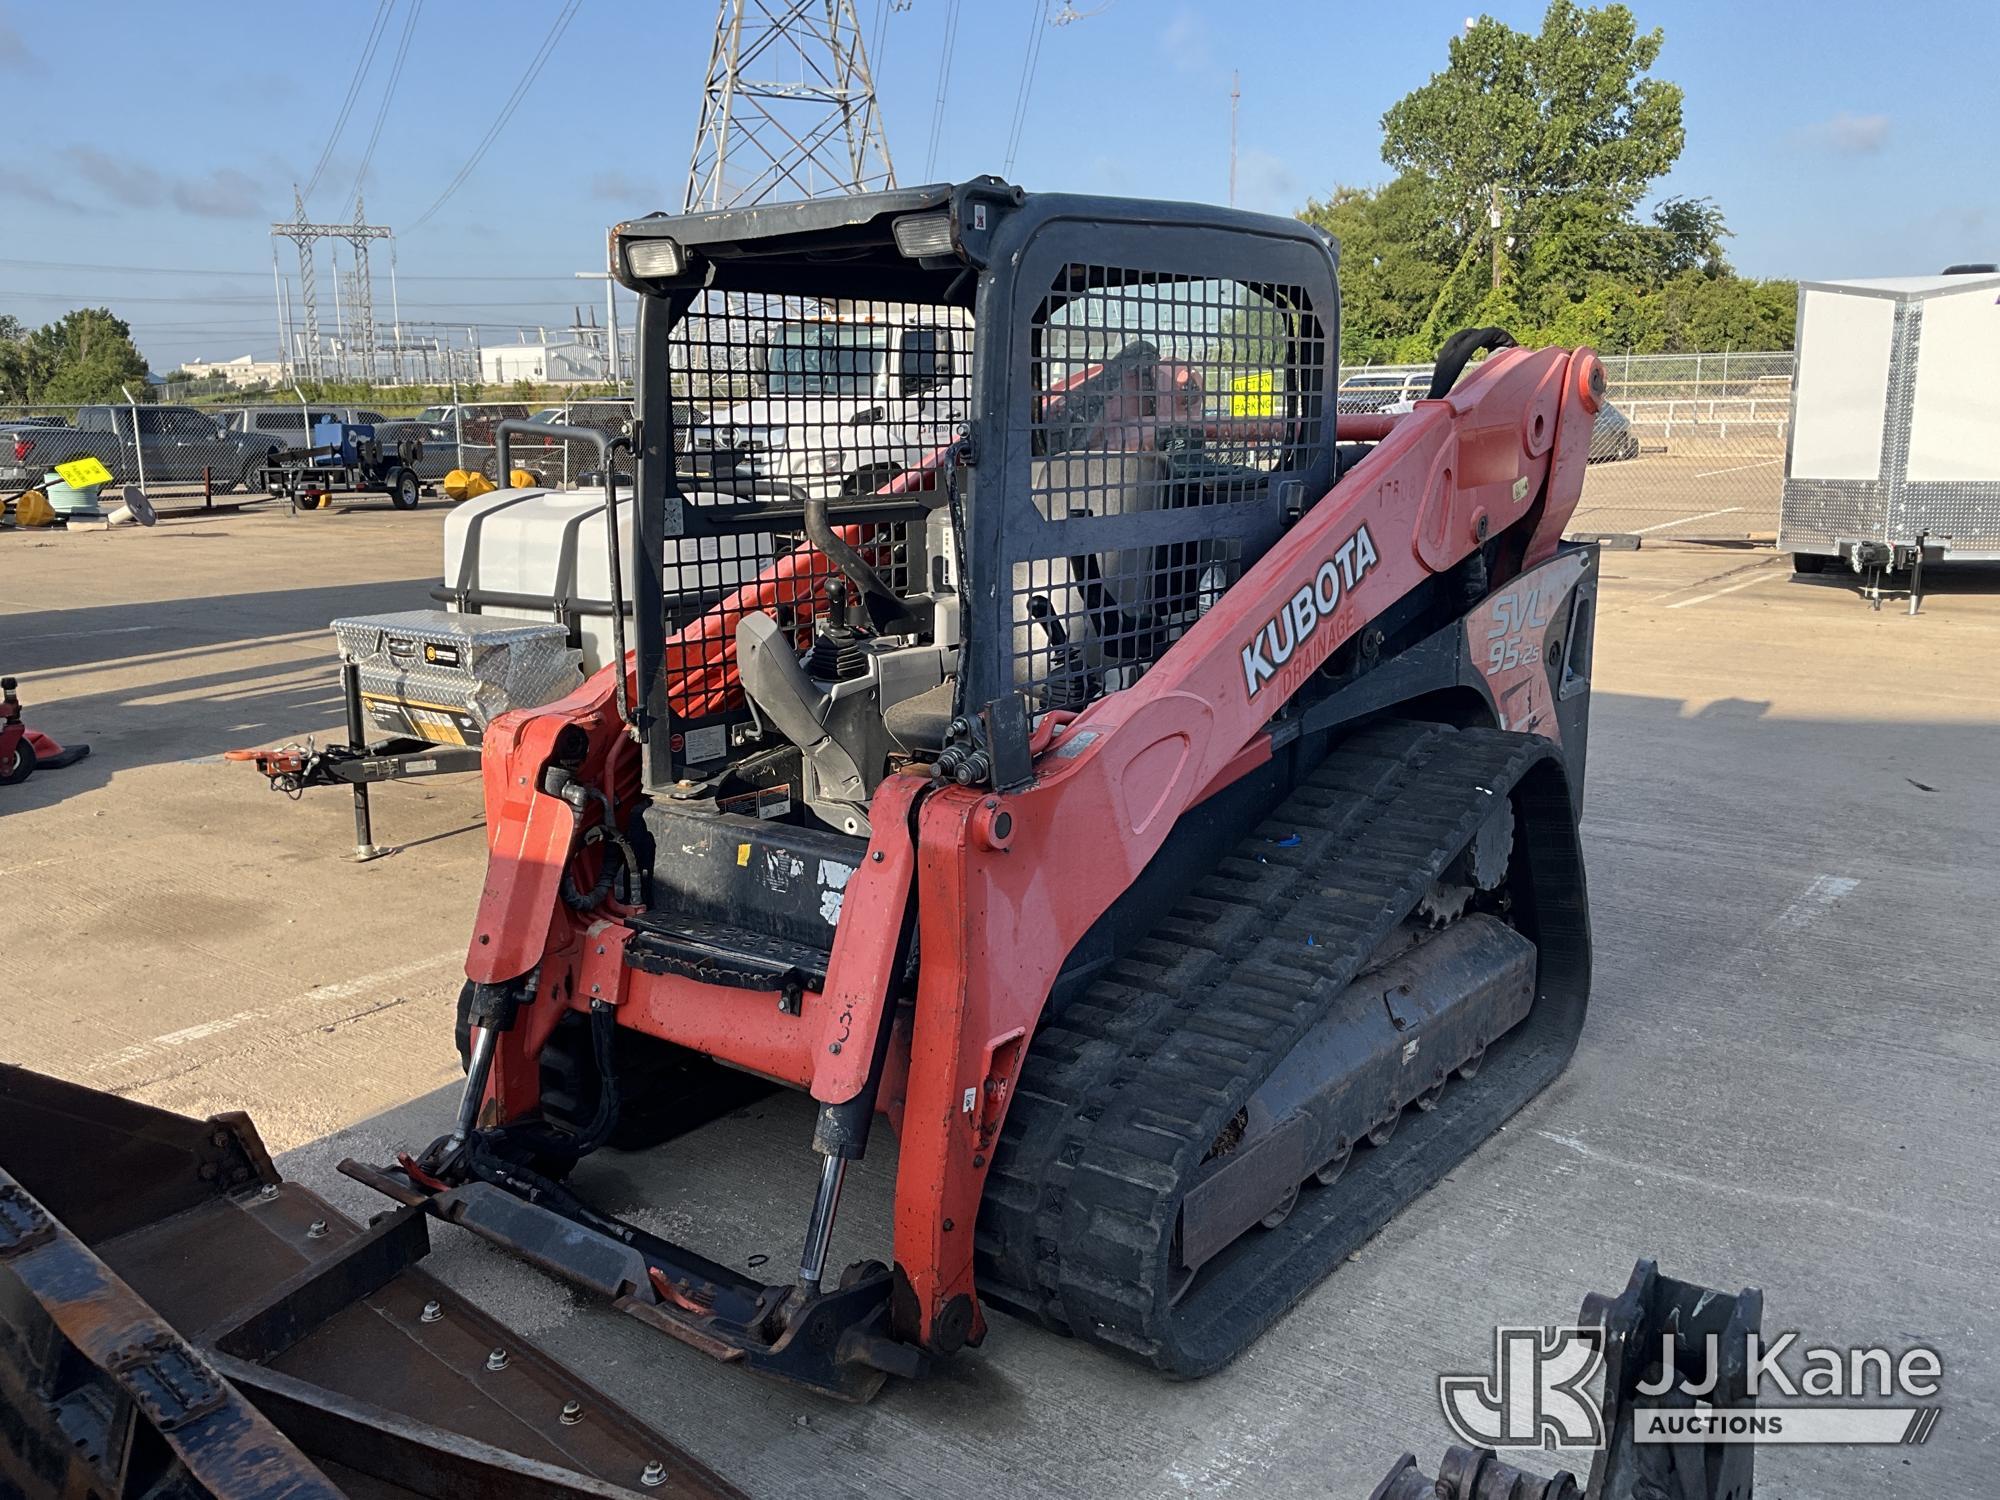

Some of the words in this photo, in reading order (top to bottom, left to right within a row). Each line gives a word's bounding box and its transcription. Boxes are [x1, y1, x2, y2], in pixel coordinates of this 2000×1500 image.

[1234, 400, 1271, 413] PARKNG
[1235, 378, 1271, 391] AUCTON
[1241, 525, 1378, 697] KUBOTA
[1487, 589, 1547, 640] SVL
[1282, 604, 1354, 697] DRAINAGE
